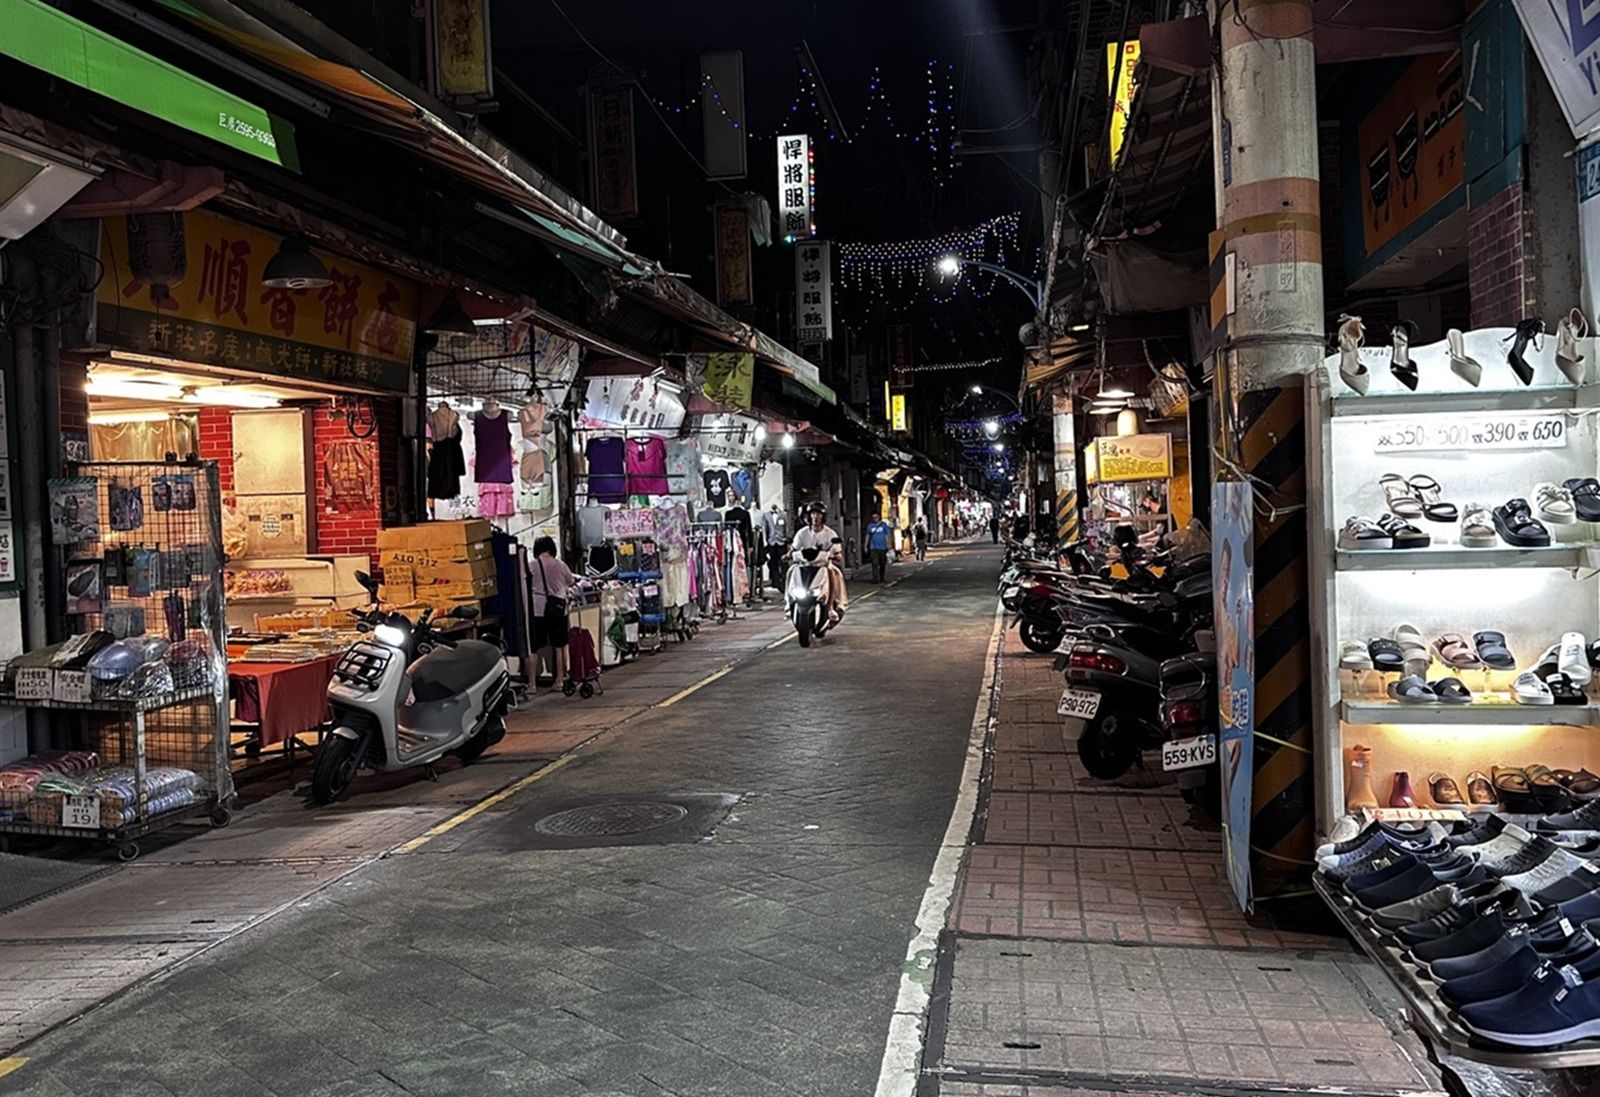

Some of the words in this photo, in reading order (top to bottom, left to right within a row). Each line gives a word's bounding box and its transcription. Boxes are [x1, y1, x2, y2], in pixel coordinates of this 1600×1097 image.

[782, 138, 806, 232] 悍將服飾
[712, 354, 752, 411] 泳裝
[1532, 420, 1563, 441] 650
[1164, 744, 1214, 766] 559-KVS
